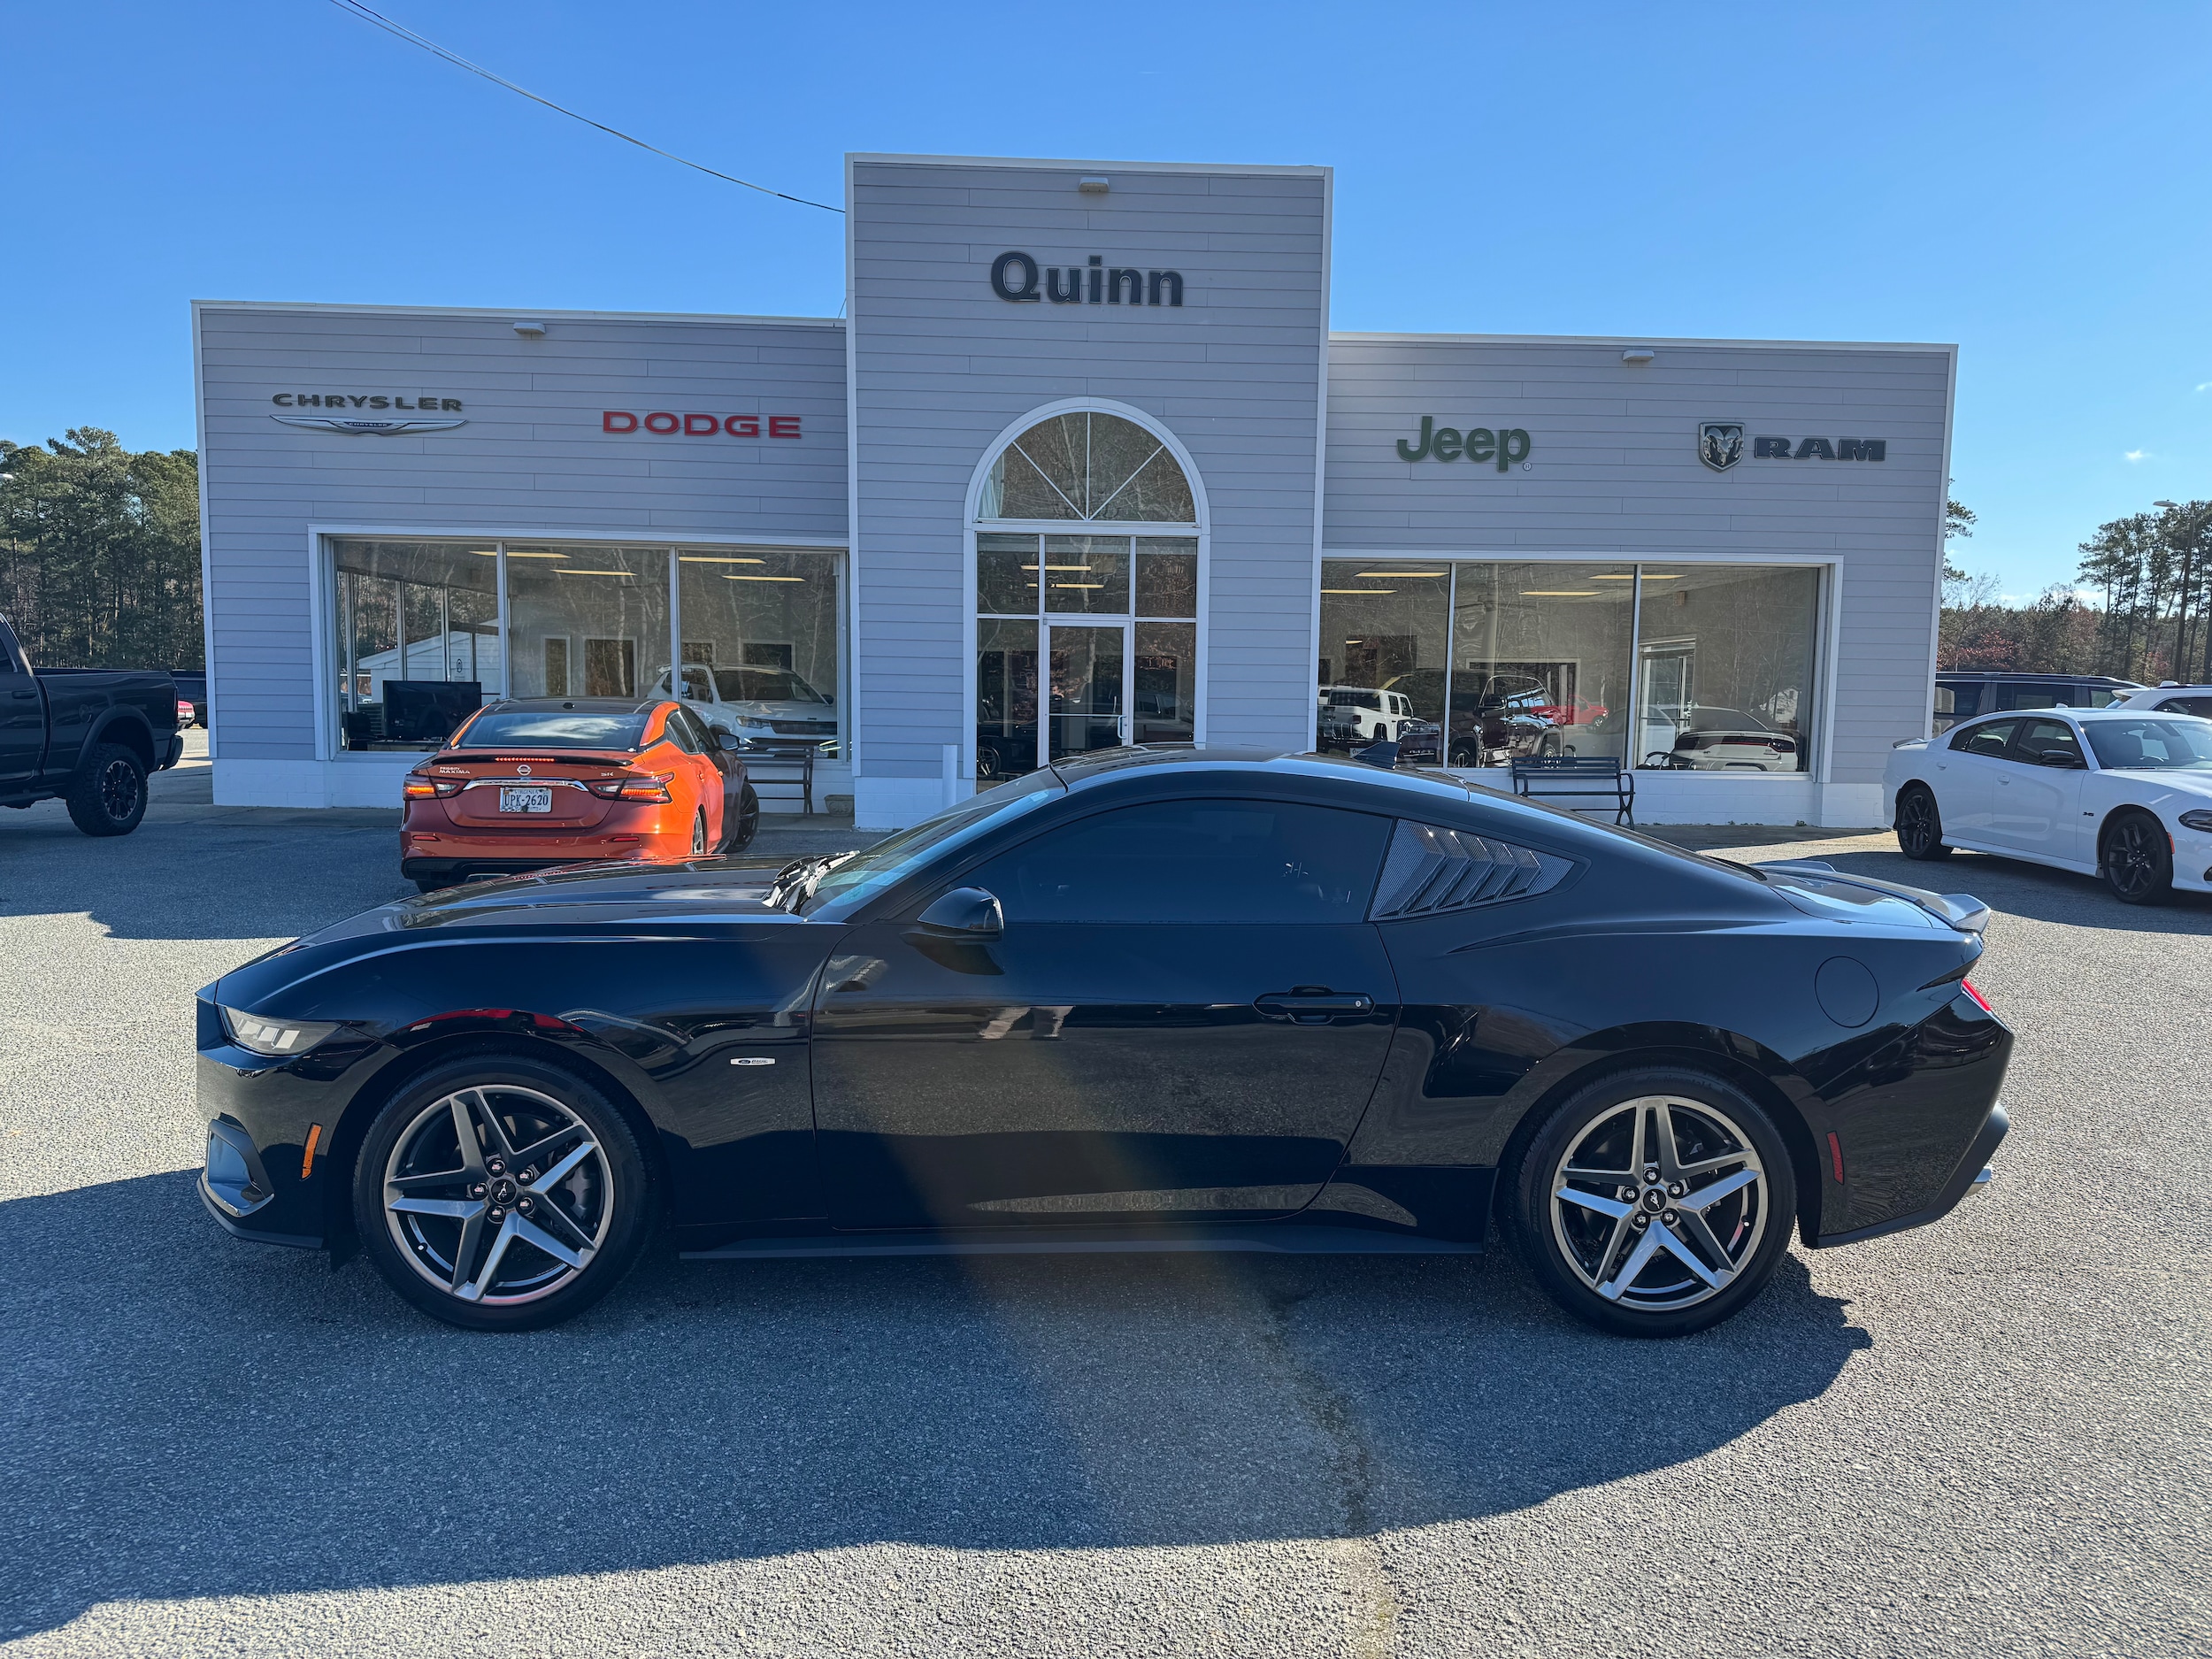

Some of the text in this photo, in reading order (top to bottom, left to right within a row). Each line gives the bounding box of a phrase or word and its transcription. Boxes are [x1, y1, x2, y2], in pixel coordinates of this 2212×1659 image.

[991, 250, 1183, 307] Quinn
[272, 393, 463, 412] CHRYSLER
[603, 411, 803, 439] DODGE
[1397, 415, 1531, 472] Jeep
[1755, 436, 1887, 462] RAM
[504, 795, 549, 807] UPK-2620
